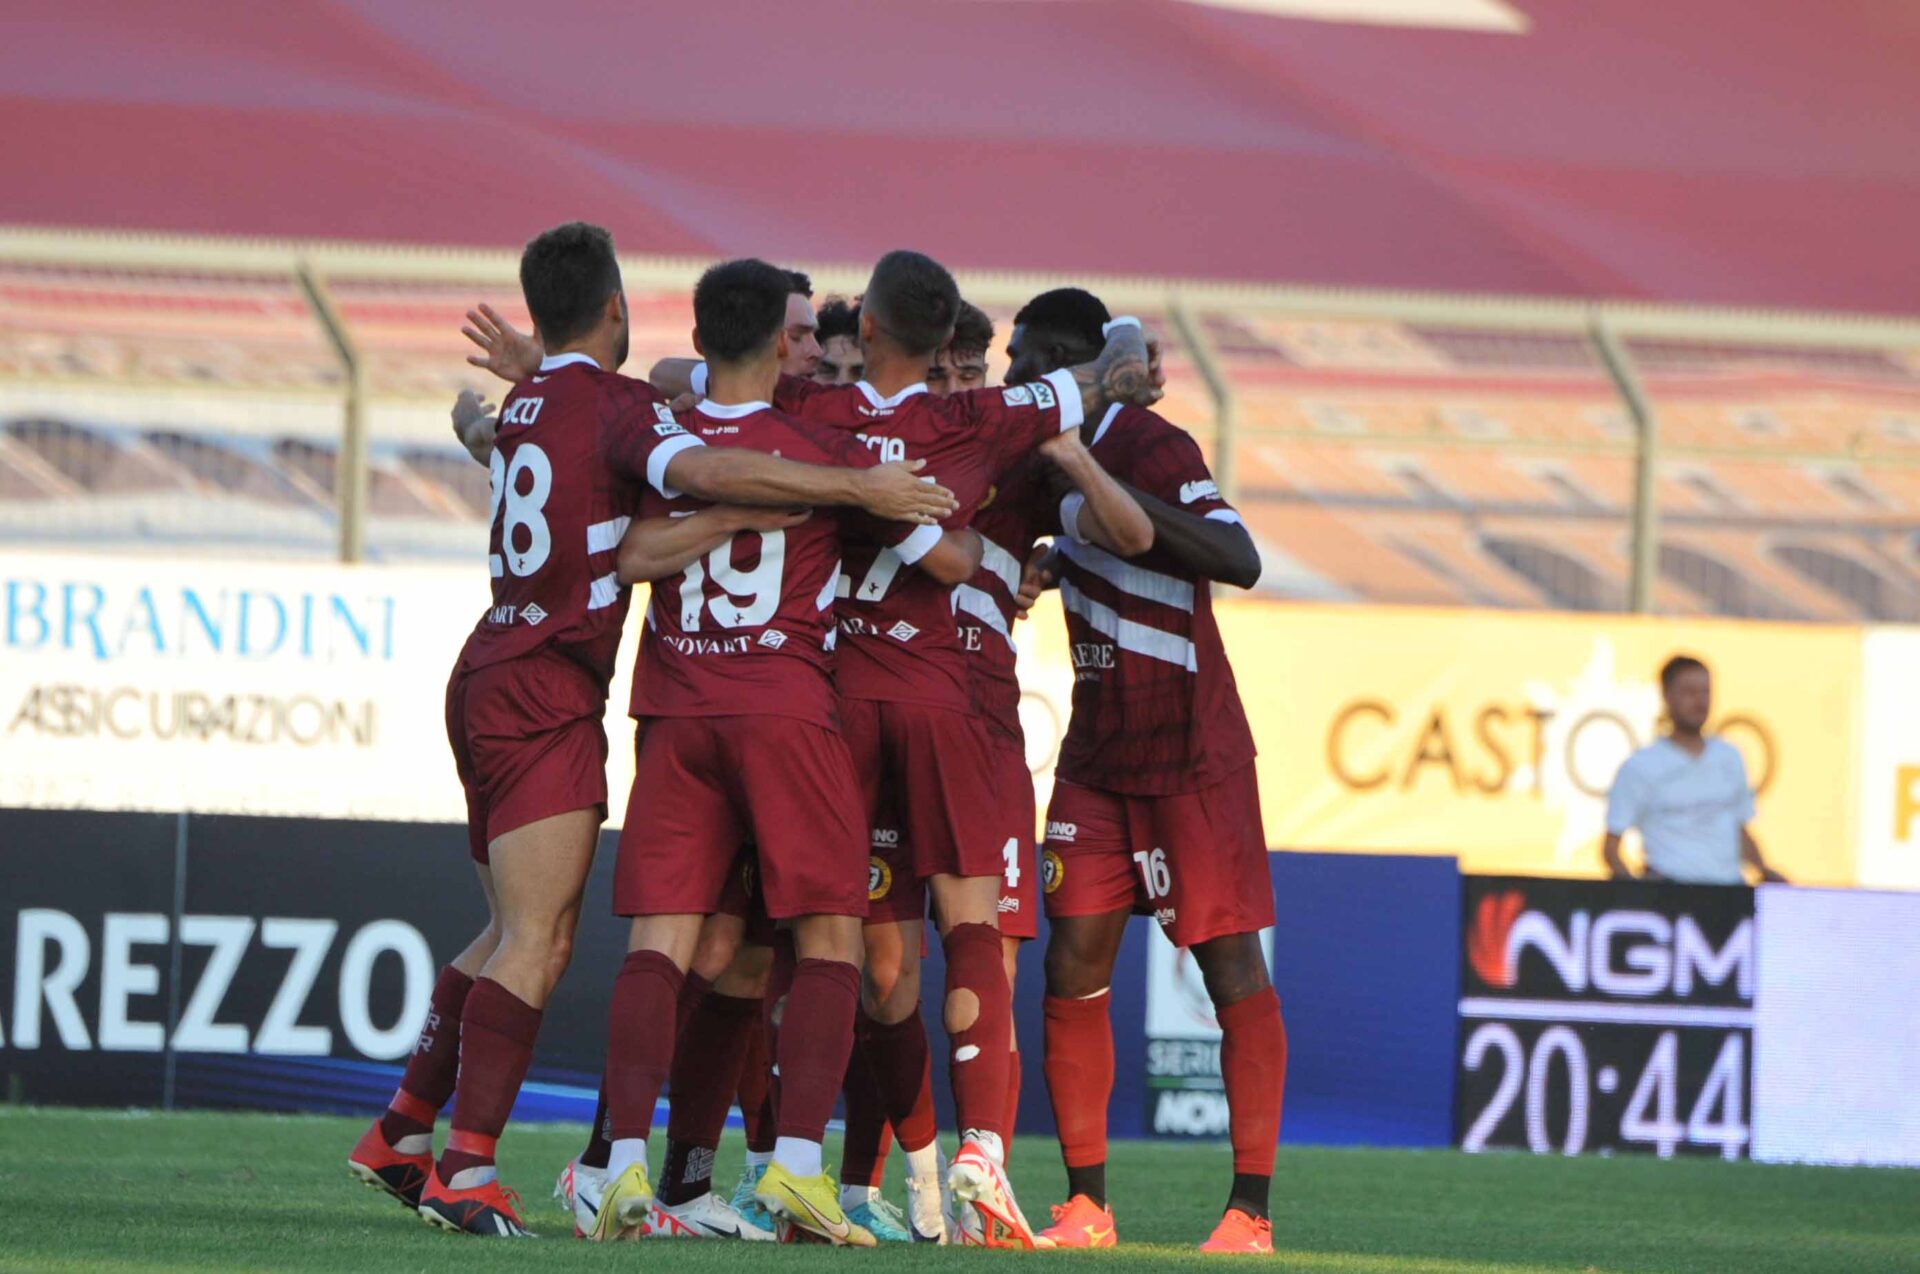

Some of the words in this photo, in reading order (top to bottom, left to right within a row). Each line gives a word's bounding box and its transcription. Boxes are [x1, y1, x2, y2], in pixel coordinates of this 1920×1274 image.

[669, 511, 785, 632] 19
[3, 578, 396, 661] BRANDINI
[8, 684, 375, 746] ASSICURAZIONI
[1133, 847, 1171, 899] 16
[0, 908, 435, 1061] REZZO
[1505, 909, 1754, 998] NGM
